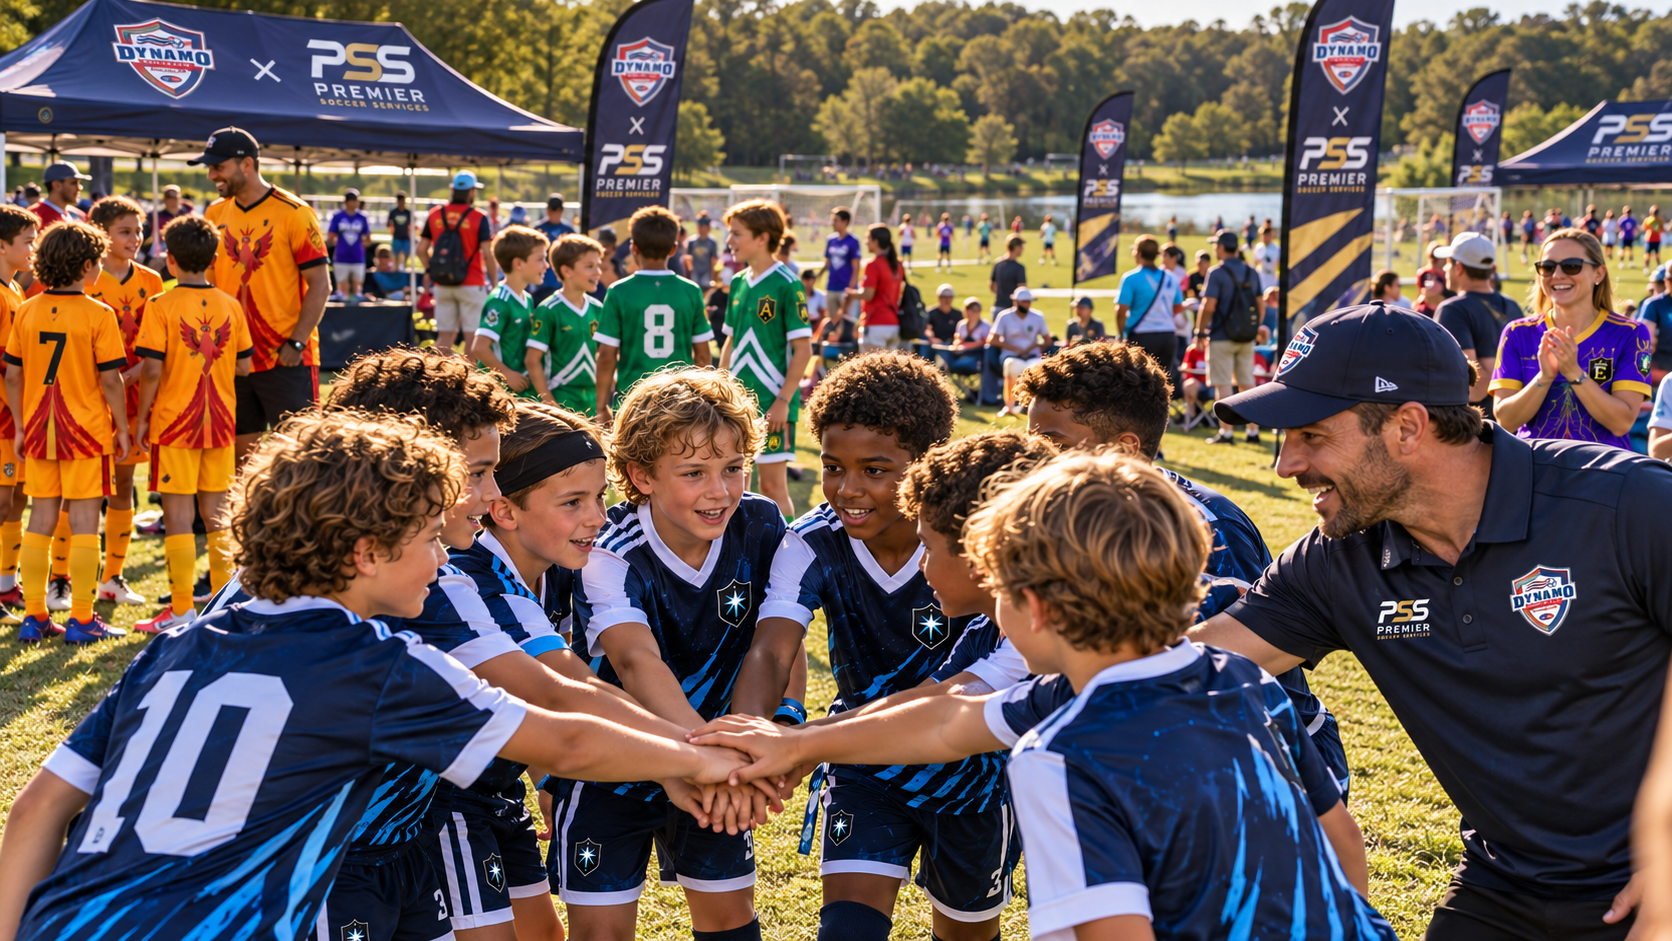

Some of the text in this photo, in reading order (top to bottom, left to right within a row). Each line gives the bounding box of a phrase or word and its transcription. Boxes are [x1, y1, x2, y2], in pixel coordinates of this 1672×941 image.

[116, 45, 211, 66] DYNAMO
[306, 39, 415, 84] PSS
[1316, 45, 1377, 59] DYNAMO
[614, 61, 673, 76] DYNAMO
[313, 82, 425, 103] PREMIER
[320, 98, 429, 112] SOCCER SERVICES
[1591, 113, 1672, 145] PSS
[598, 143, 667, 175] PSS
[1299, 136, 1372, 170] PSS
[1587, 144, 1672, 158] PREMIER
[1297, 172, 1367, 185] PREMIER
[1457, 164, 1494, 182] PSS
[596, 179, 661, 190] PREMIER
[1084, 179, 1120, 196] PSS
[643, 303, 675, 359] 8
[39, 330, 67, 385] 7
[1594, 366, 1607, 379] E
[1512, 585, 1574, 609] DYNAMO
[1378, 598, 1430, 624] PSS
[1377, 623, 1430, 635] PREMIER
[77, 670, 294, 857] 10
[986, 867, 1002, 898] 3
[433, 888, 449, 921] 3
